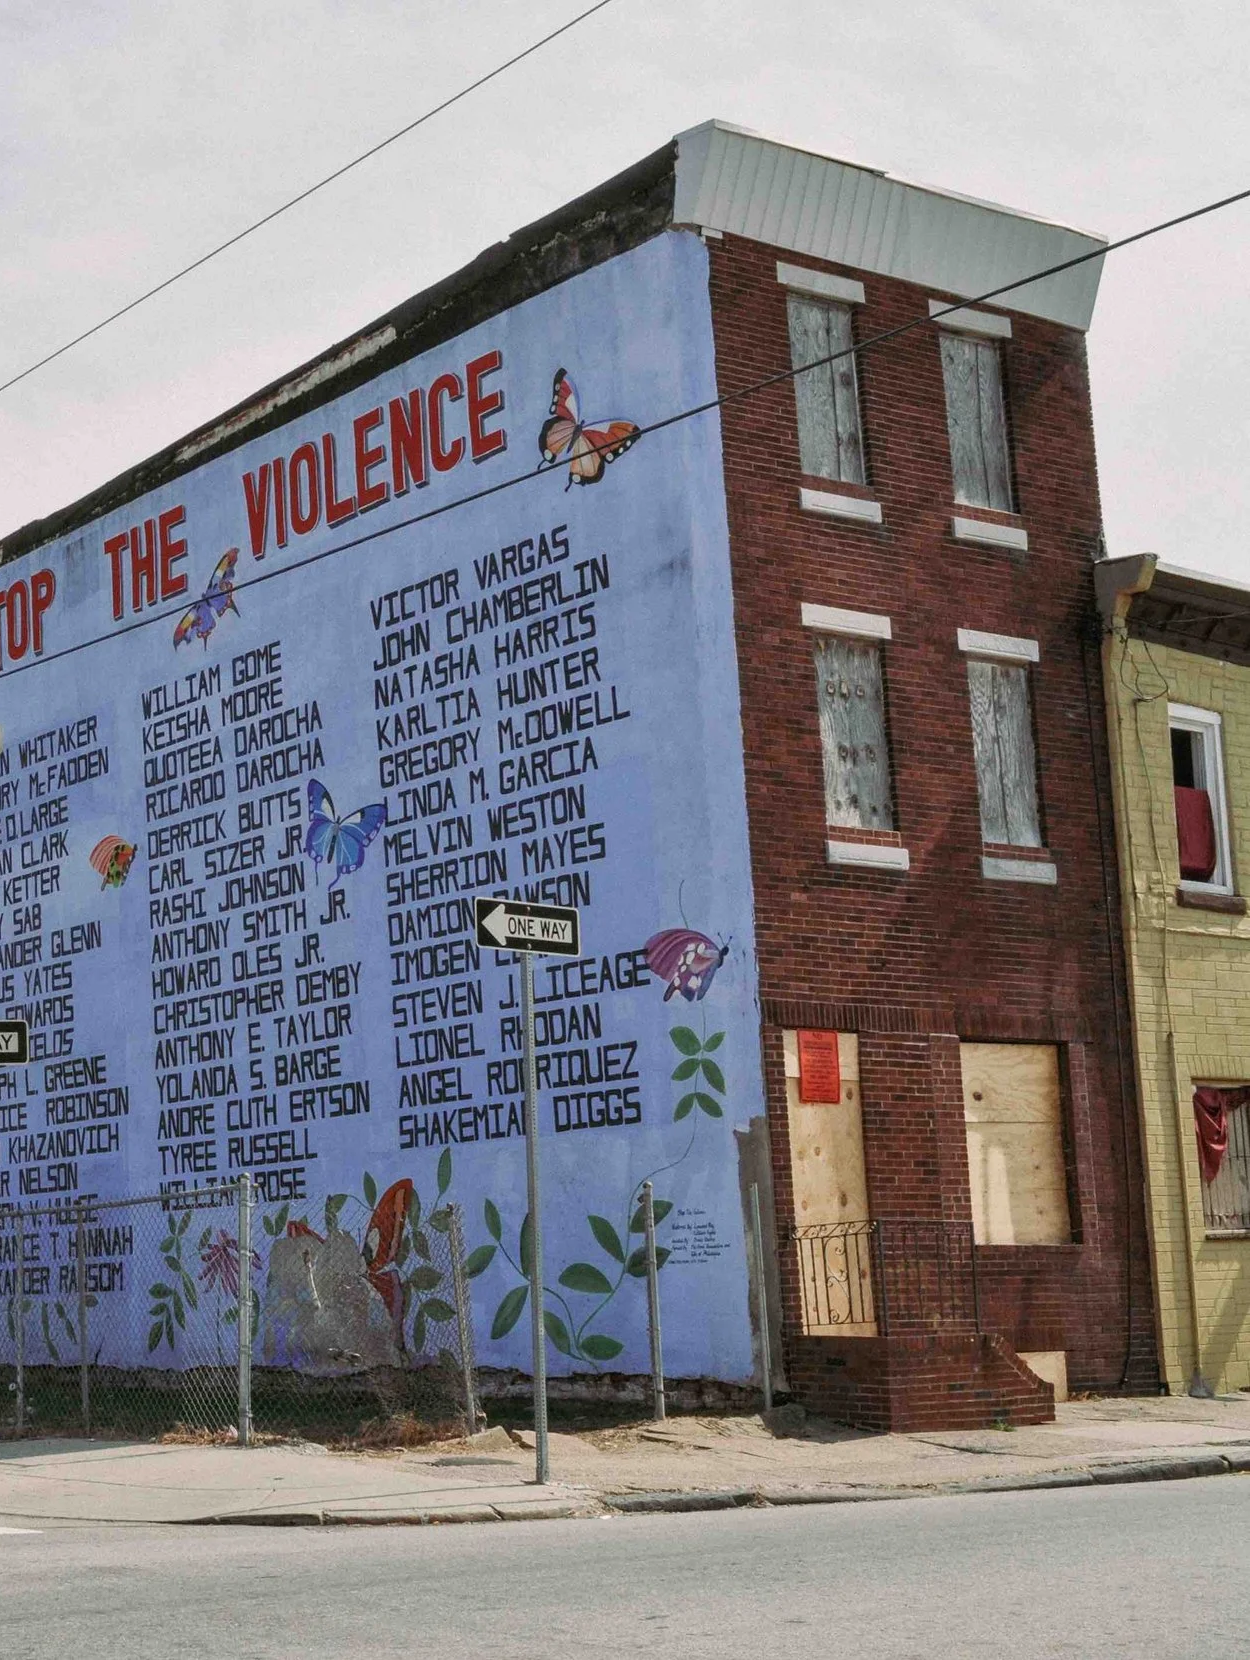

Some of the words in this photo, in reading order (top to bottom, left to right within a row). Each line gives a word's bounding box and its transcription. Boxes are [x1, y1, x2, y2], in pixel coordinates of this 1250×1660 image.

[104, 505, 188, 621] THE
[242, 349, 507, 561] VIOLENCE
[370, 568, 460, 631] VICTOR
[473, 524, 570, 590] VARGAS
[373, 620, 431, 672] JOHN
[446, 554, 610, 644] CHAMBERLIN
[142, 664, 221, 720] WILLIAM
[232, 640, 282, 686] GOME
[374, 644, 480, 710] NATASHA
[494, 602, 596, 669] HARRIS
[143, 705, 212, 755] KEISHA
[221, 677, 283, 727] MOORE
[376, 687, 481, 751] KARLTIA
[496, 646, 601, 711] HUNTER
[18, 716, 98, 769] WHITAKER
[144, 736, 223, 788] QUOTEEA
[234, 700, 323, 757] DAROCHA
[379, 727, 480, 789] GREGORY
[497, 685, 631, 754] McDOWELL
[146, 770, 226, 822] RICARDO
[236, 738, 325, 793] DAROCHA
[384, 778, 457, 827] LINDA
[469, 767, 490, 804] M.
[499, 736, 598, 795] GARCIA
[21, 796, 69, 838] LARGE
[147, 809, 227, 860] DERRICK
[238, 787, 302, 834] BUTTS
[384, 814, 473, 867] MELVIN
[487, 784, 585, 842] WESTON
[21, 830, 69, 869] CLARK
[149, 857, 194, 895] CARL
[205, 835, 265, 880] SIZER
[387, 848, 507, 907] SHERRION
[521, 823, 606, 876] MAYES
[3, 866, 60, 907] KETTER
[150, 887, 206, 930] RASHI
[218, 861, 305, 912] JOHNSON
[388, 896, 476, 946] DAMION
[493, 871, 591, 908] WSON
[13, 903, 42, 936] SAB
[51, 920, 102, 958] GLENN
[151, 917, 230, 964] ANTHONY
[243, 899, 307, 943] SMITH
[320, 888, 351, 925] JR.
[508, 917, 535, 938] ONE
[540, 920, 569, 941] WAY
[24, 961, 73, 997] YATES
[152, 956, 221, 1000] HOWARD
[232, 943, 282, 983] OLES
[295, 933, 325, 968] JR.
[390, 939, 480, 986] IMOGEN
[154, 979, 285, 1035] CHRISTOPHER
[296, 962, 361, 1006] DEMBY
[392, 979, 483, 1028] STEVEN
[155, 1027, 235, 1070] ANTHONY
[248, 1022, 266, 1054] E.
[273, 1003, 352, 1048] TAYLOR
[394, 1023, 485, 1069] LIONEL
[44, 1055, 106, 1093] GREENE
[156, 1064, 238, 1105] YOLANDA
[250, 1059, 267, 1091] S.
[274, 1045, 342, 1087] BARGE
[399, 1067, 472, 1109] ANGEL
[46, 1086, 129, 1126] ROBINSON
[157, 1103, 215, 1140] ANDRE
[553, 1086, 642, 1133] DIGGS
[9, 1123, 119, 1165] KHAZANOVICH
[158, 1140, 217, 1175] TYREE
[228, 1128, 318, 1168] RUSSELL
[19, 1162, 78, 1195] NELSON
[254, 1167, 307, 1203] ROSE
